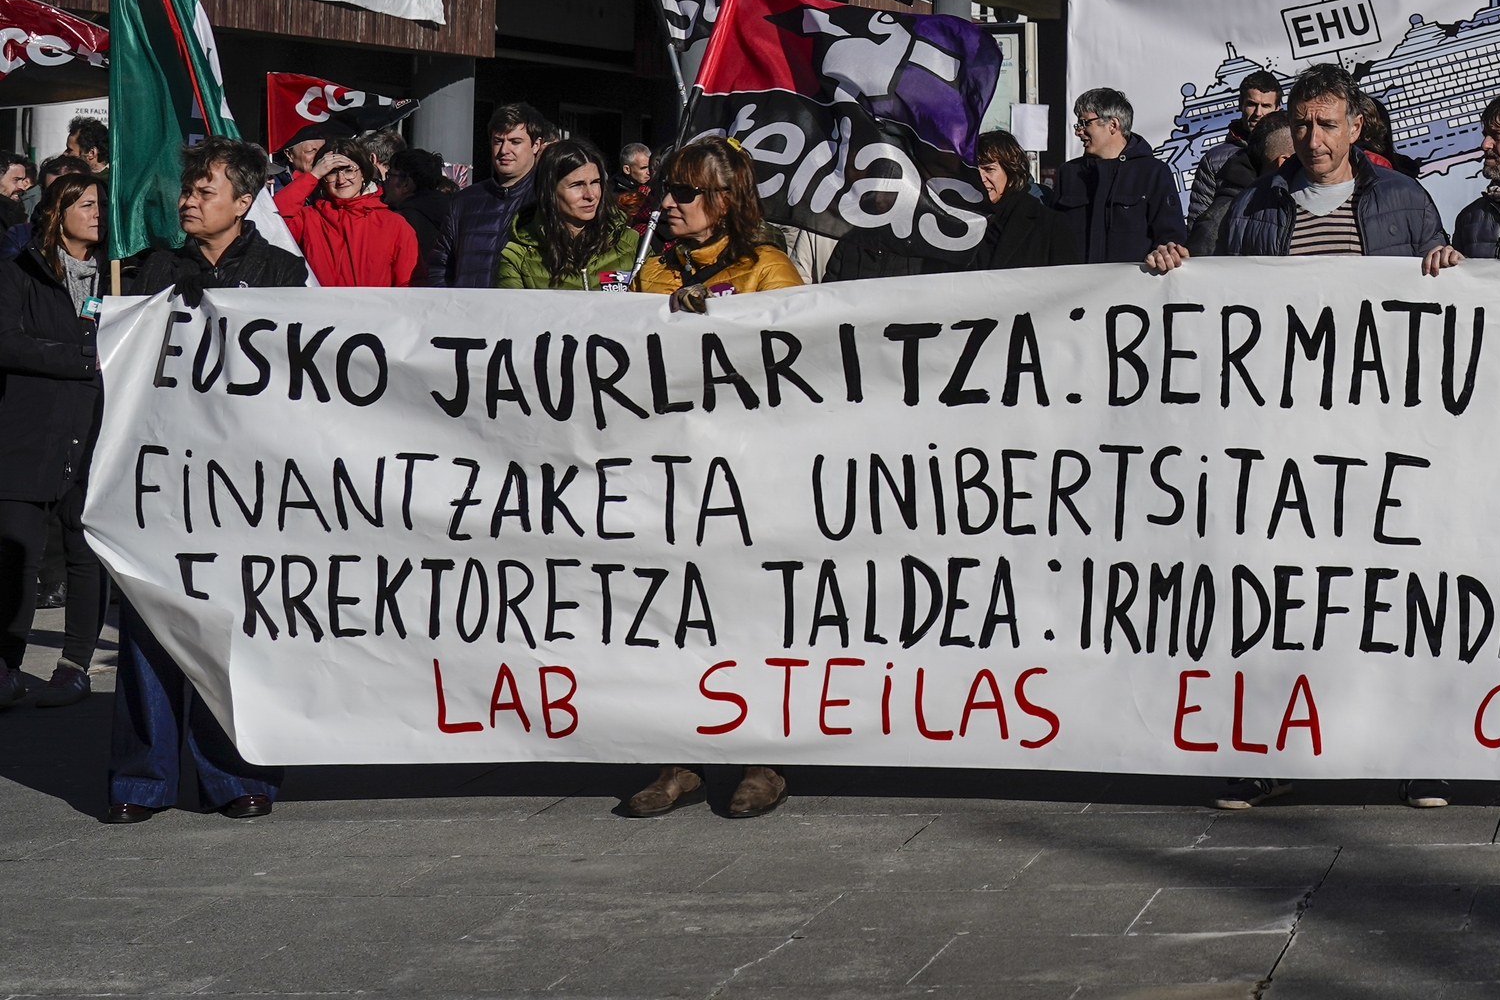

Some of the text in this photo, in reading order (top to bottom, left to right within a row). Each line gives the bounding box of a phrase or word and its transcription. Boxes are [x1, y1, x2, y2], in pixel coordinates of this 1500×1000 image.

[1291, 2, 1370, 47] EHU
[154, 311, 388, 406] EUSKO
[1106, 299, 1484, 417] BERMATU
[433, 658, 578, 739] LAB
[1174, 669, 1322, 756] ELA
